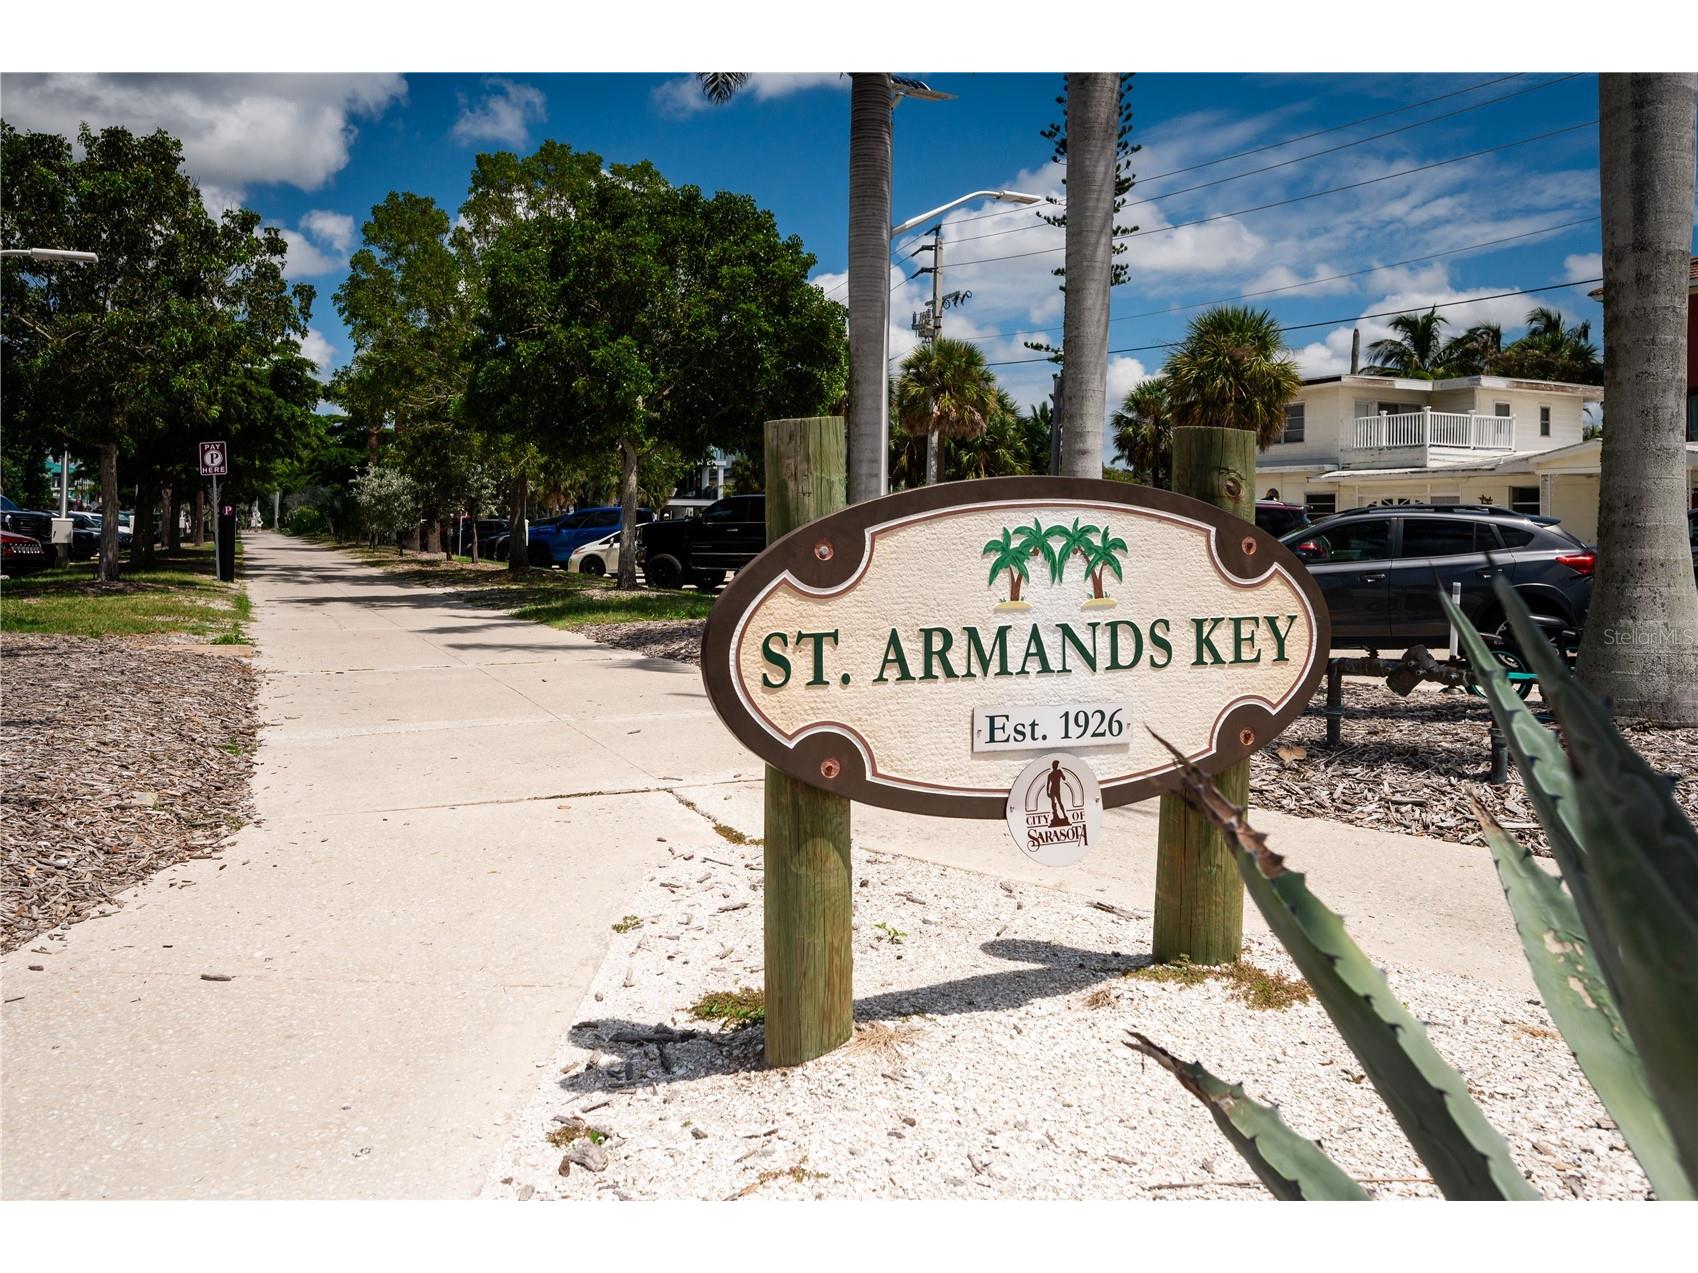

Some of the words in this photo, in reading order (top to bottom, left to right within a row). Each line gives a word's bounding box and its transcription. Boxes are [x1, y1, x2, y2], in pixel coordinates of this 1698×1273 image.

[761, 628, 850, 688] ST.
[873, 618, 1173, 682] ARMANDS
[1191, 614, 1298, 666] KEY
[984, 713, 1048, 745] Est.
[1059, 707, 1124, 740] 1926
[1026, 814, 1050, 826] CITY
[1072, 811, 1085, 821] OF
[1027, 824, 1088, 852] SARASOTA
